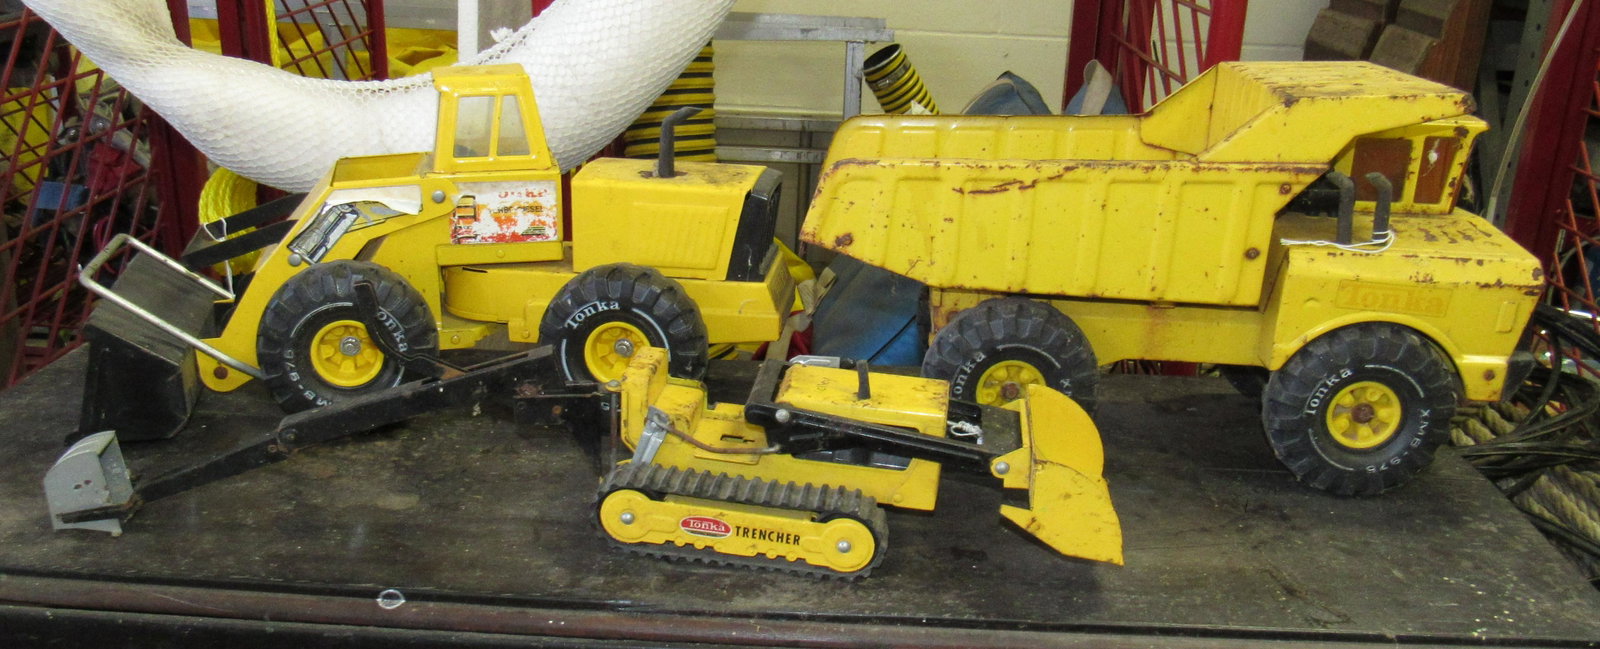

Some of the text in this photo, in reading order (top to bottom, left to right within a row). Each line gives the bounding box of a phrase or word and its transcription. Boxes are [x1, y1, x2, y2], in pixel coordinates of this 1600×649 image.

[565, 301, 620, 329] Tonka
[1341, 281, 1445, 313] Tonka
[376, 311, 409, 352] onka
[283, 349, 333, 406] MB-975
[953, 351, 986, 395] onka
[1304, 368, 1353, 415] Tonka
[686, 519, 801, 545] Tonka TRENCHER
